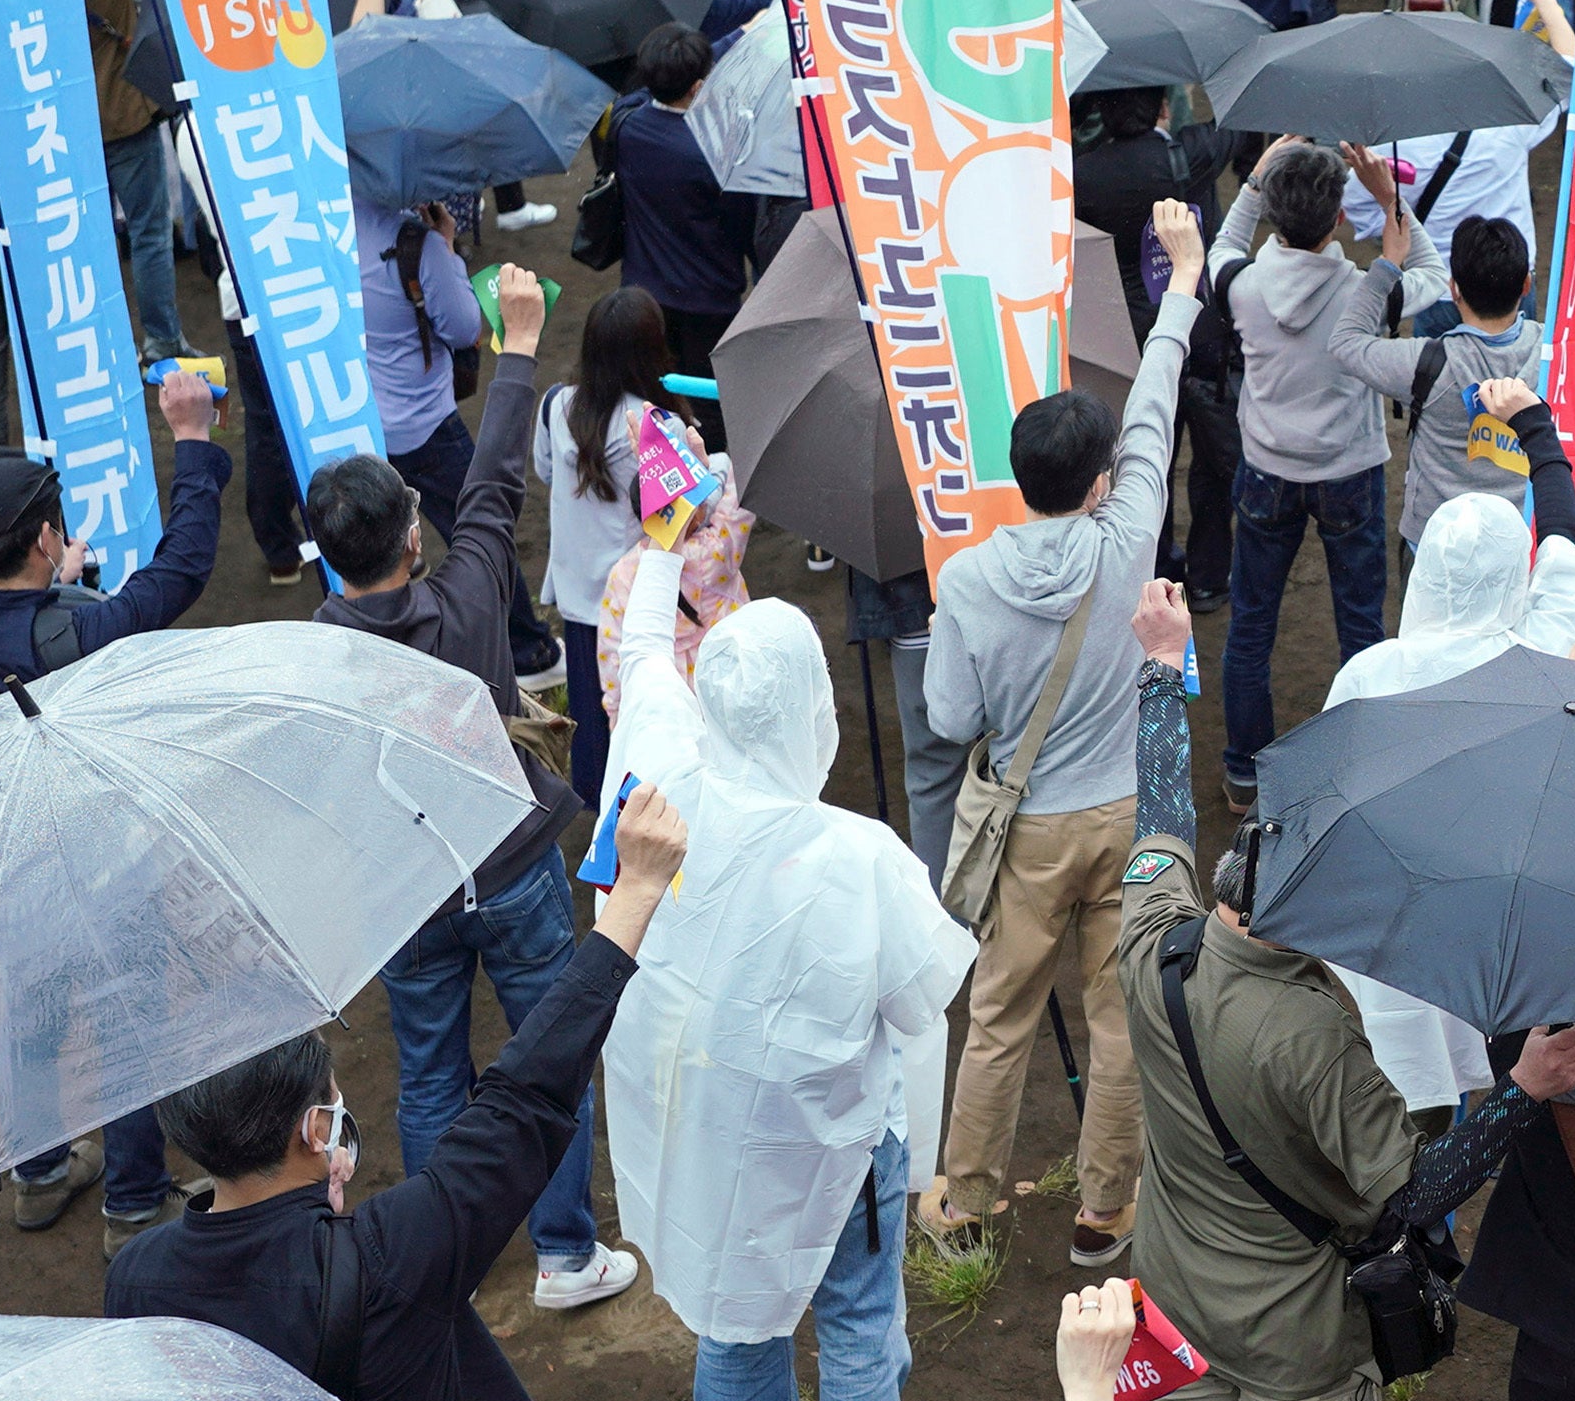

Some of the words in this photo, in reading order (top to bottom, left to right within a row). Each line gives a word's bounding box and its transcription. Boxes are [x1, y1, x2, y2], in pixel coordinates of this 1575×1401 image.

[1471, 425, 1493, 443] NO
[1495, 433, 1527, 457] WA
[1133, 1359, 1162, 1388] 93
